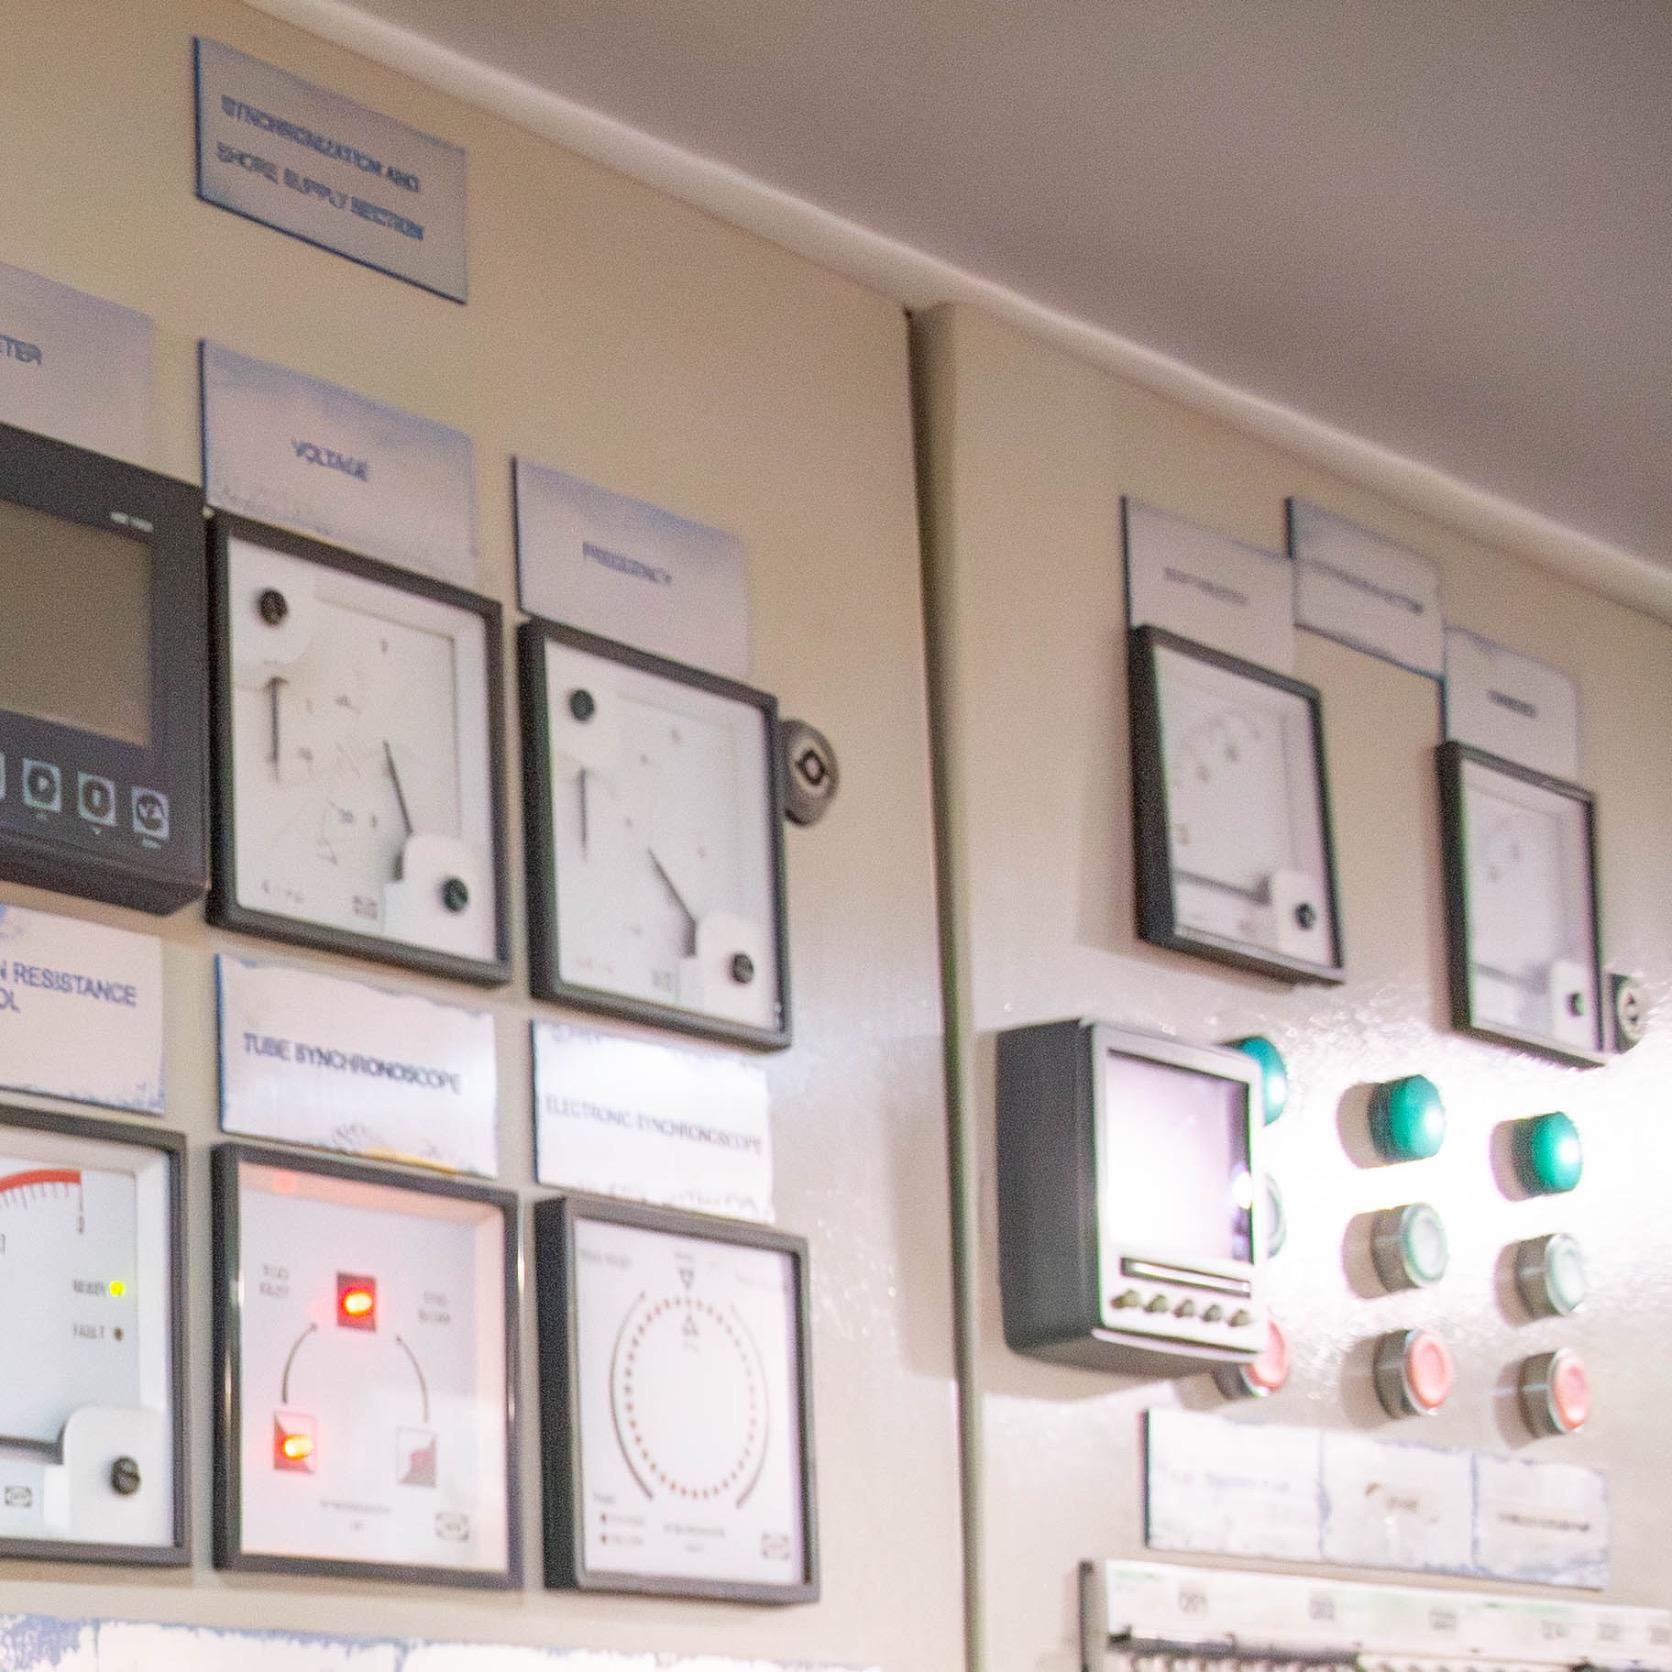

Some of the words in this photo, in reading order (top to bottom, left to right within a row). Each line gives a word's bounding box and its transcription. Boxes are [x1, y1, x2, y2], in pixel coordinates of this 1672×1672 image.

[14, 962, 137, 1008] RESISTANCE
[243, 1032, 290, 1062] TUBE
[295, 1041, 462, 1094] SYNCHRONOSCOPE
[545, 1096, 632, 1129] ELECTRONIC
